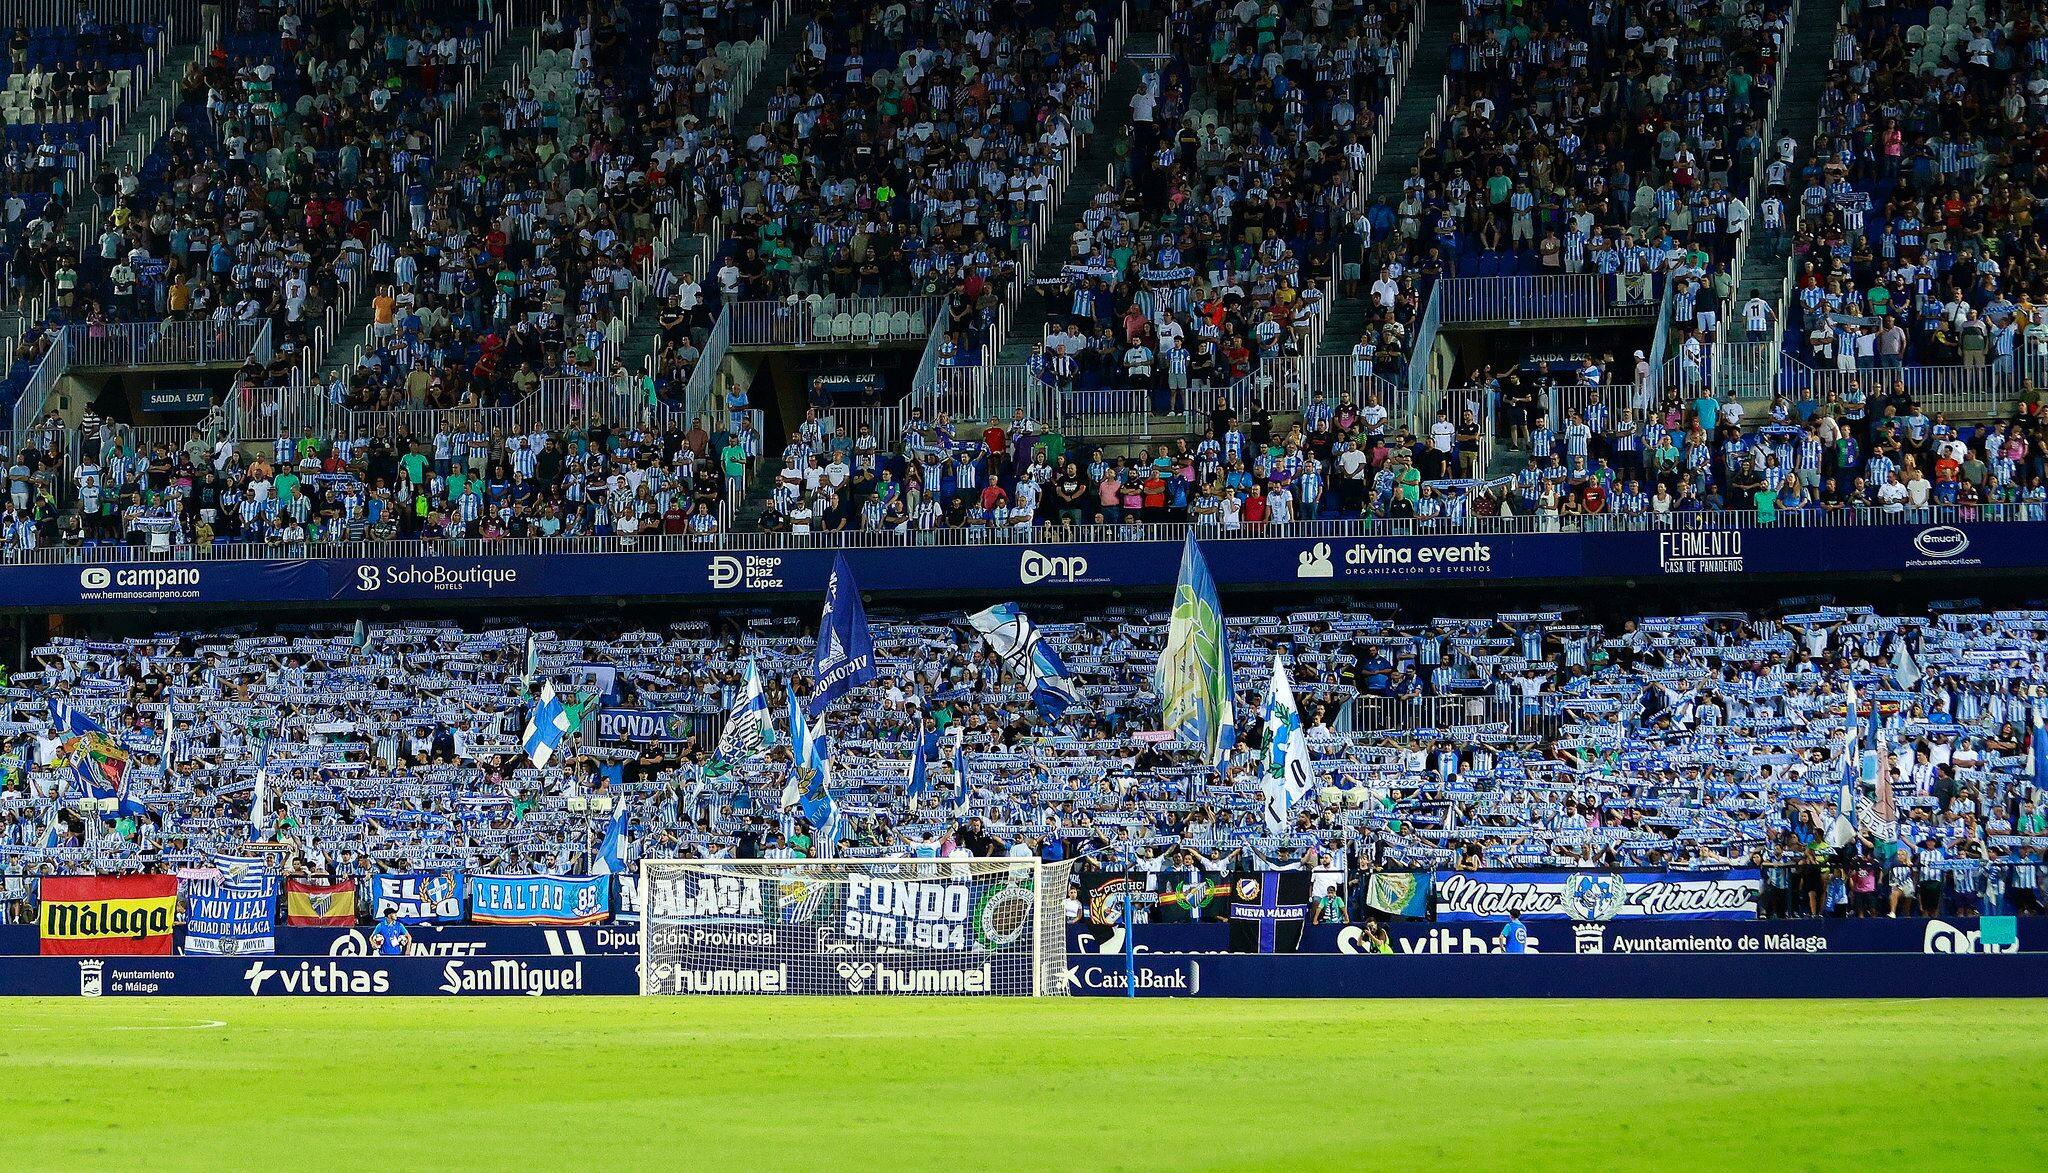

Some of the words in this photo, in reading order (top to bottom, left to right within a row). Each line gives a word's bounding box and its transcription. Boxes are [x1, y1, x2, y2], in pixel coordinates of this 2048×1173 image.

[1773, 167, 1780, 177] 7
[1767, 205, 1773, 215] 8
[1750, 304, 1760, 315] 11
[855, 374, 876, 383] EXIT
[150, 394, 182, 404] SALIDA
[186, 393, 205, 403] EXIT
[1660, 531, 1741, 567] FERMENTO
[1922, 534, 1961, 543] emucril
[746, 555, 782, 568] Diego
[1345, 543, 1412, 565] divina
[1417, 541, 1491, 563] events
[386, 564, 517, 589] SohoBoutique
[746, 566, 773, 577] Díaz
[1345, 566, 1424, 575] ORGANIZACIÓN
[1447, 565, 1491, 573] EVENTOS
[1664, 561, 1684, 573] CASA
[1687, 561, 1696, 573] DE
[1699, 560, 1743, 573] PANADEROS
[116, 568, 200, 590] campano
[746, 577, 783, 589] López
[80, 590, 200, 600] www.hermanoscampano.com
[601, 714, 666, 737] RONDA
[188, 877, 223, 898] MUY
[380, 877, 420, 900] EL
[476, 881, 564, 911] LEALTAD
[847, 872, 971, 921] FONDO
[1089, 887, 1102, 898] EL
[1440, 873, 1559, 917] Malaka
[1629, 879, 1751, 914] Hinchas
[190, 899, 199, 917] Y
[200, 900, 230, 919] MUY
[233, 899, 268, 920] LEAL
[374, 898, 460, 919] PALO
[1234, 907, 1265, 918] NUEVA
[1266, 905, 1304, 918] MÁLAGA
[47, 903, 170, 940] Málaga
[187, 921, 218, 935] CIUDAD
[219, 921, 231, 935] DE
[232, 918, 271, 935] MÁLAGA
[844, 910, 898, 945] SUR
[902, 919, 966, 950] 1904
[596, 929, 688, 949] Diputción
[694, 929, 777, 946] Provincial
[1613, 934, 1733, 954] Ayuntamiento
[1738, 934, 1759, 951] de
[1763, 933, 1828, 953] Málaga
[111, 969, 175, 983] Ayuntamiento
[111, 982, 123, 992] de
[125, 980, 159, 993] Málaga
[280, 961, 390, 993] vithas
[439, 959, 583, 996] SanMiguel
[674, 962, 787, 992] hummel
[877, 962, 991, 992] hummel
[1084, 967, 1188, 989] CaixaBank
